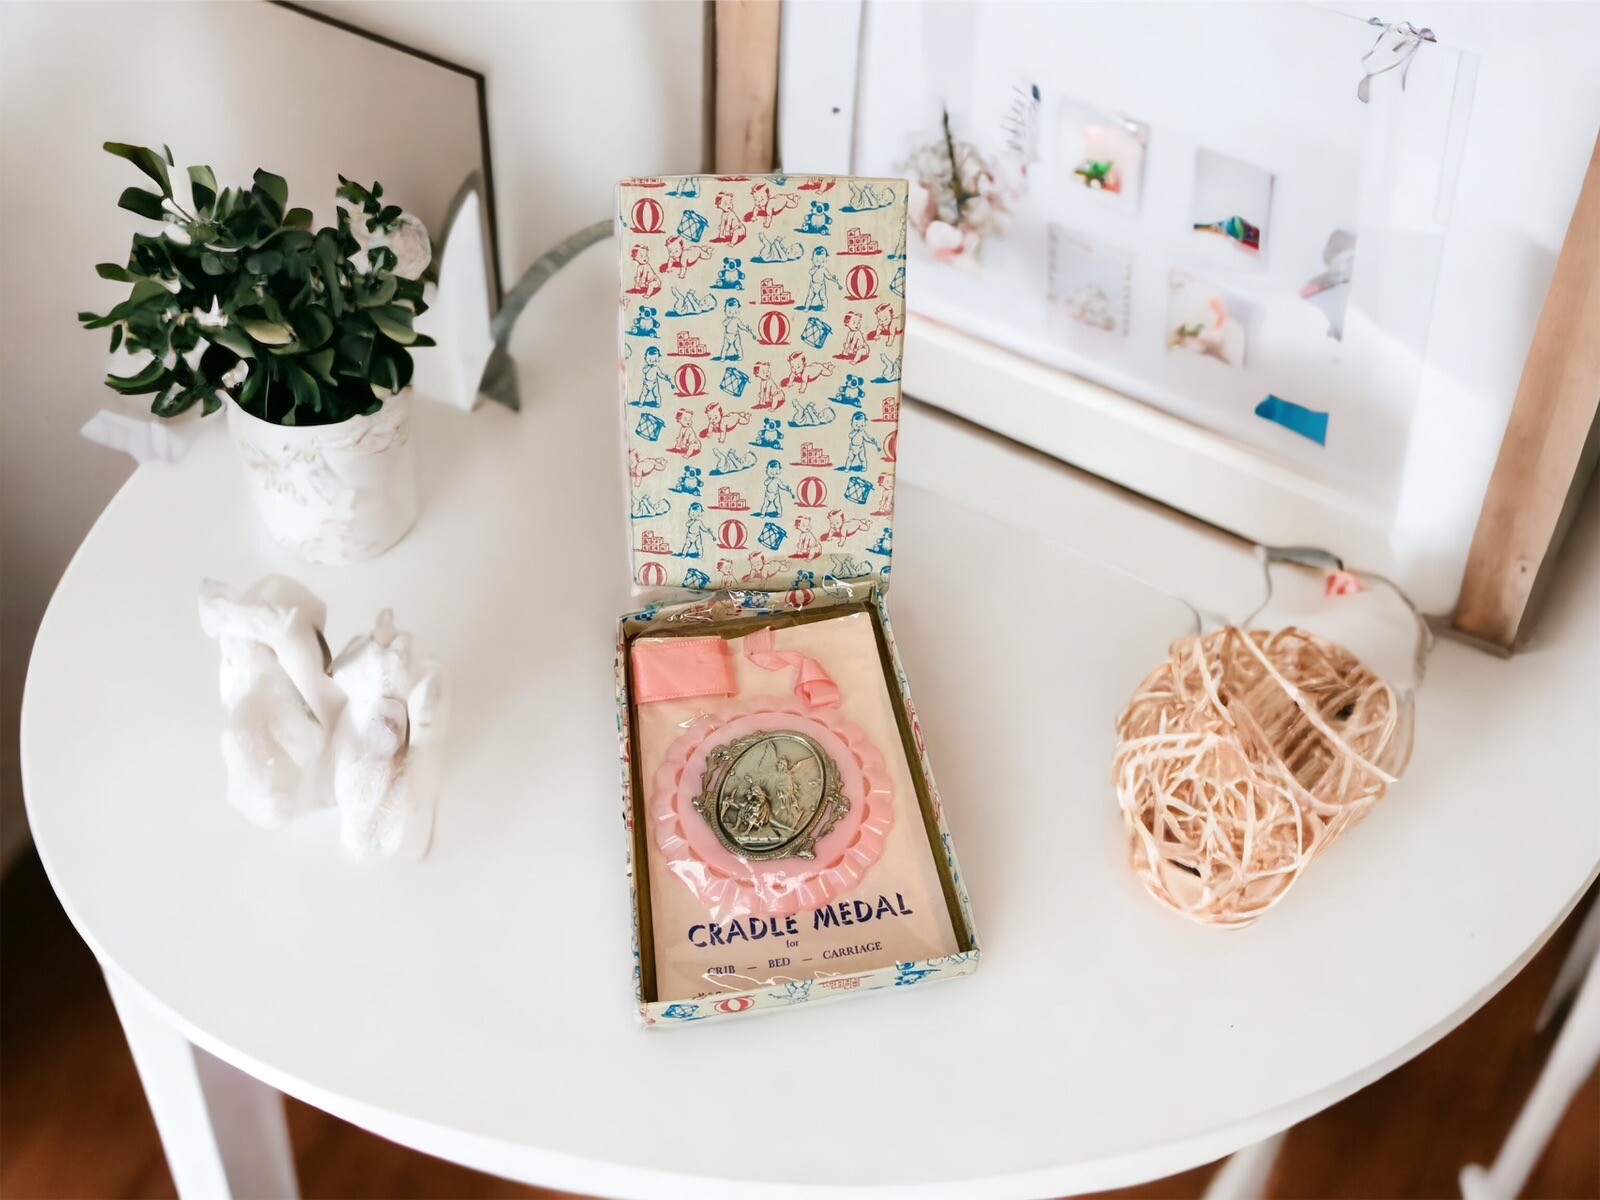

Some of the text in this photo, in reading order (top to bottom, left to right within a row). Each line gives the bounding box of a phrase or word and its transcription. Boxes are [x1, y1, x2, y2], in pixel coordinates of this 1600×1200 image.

[688, 892, 914, 948] CRADLE MEDAL
[707, 965, 736, 977] CRIB
[768, 957, 791, 969] BED
[822, 941, 883, 960] CARRIAGE
[786, 940, 799, 948] for
